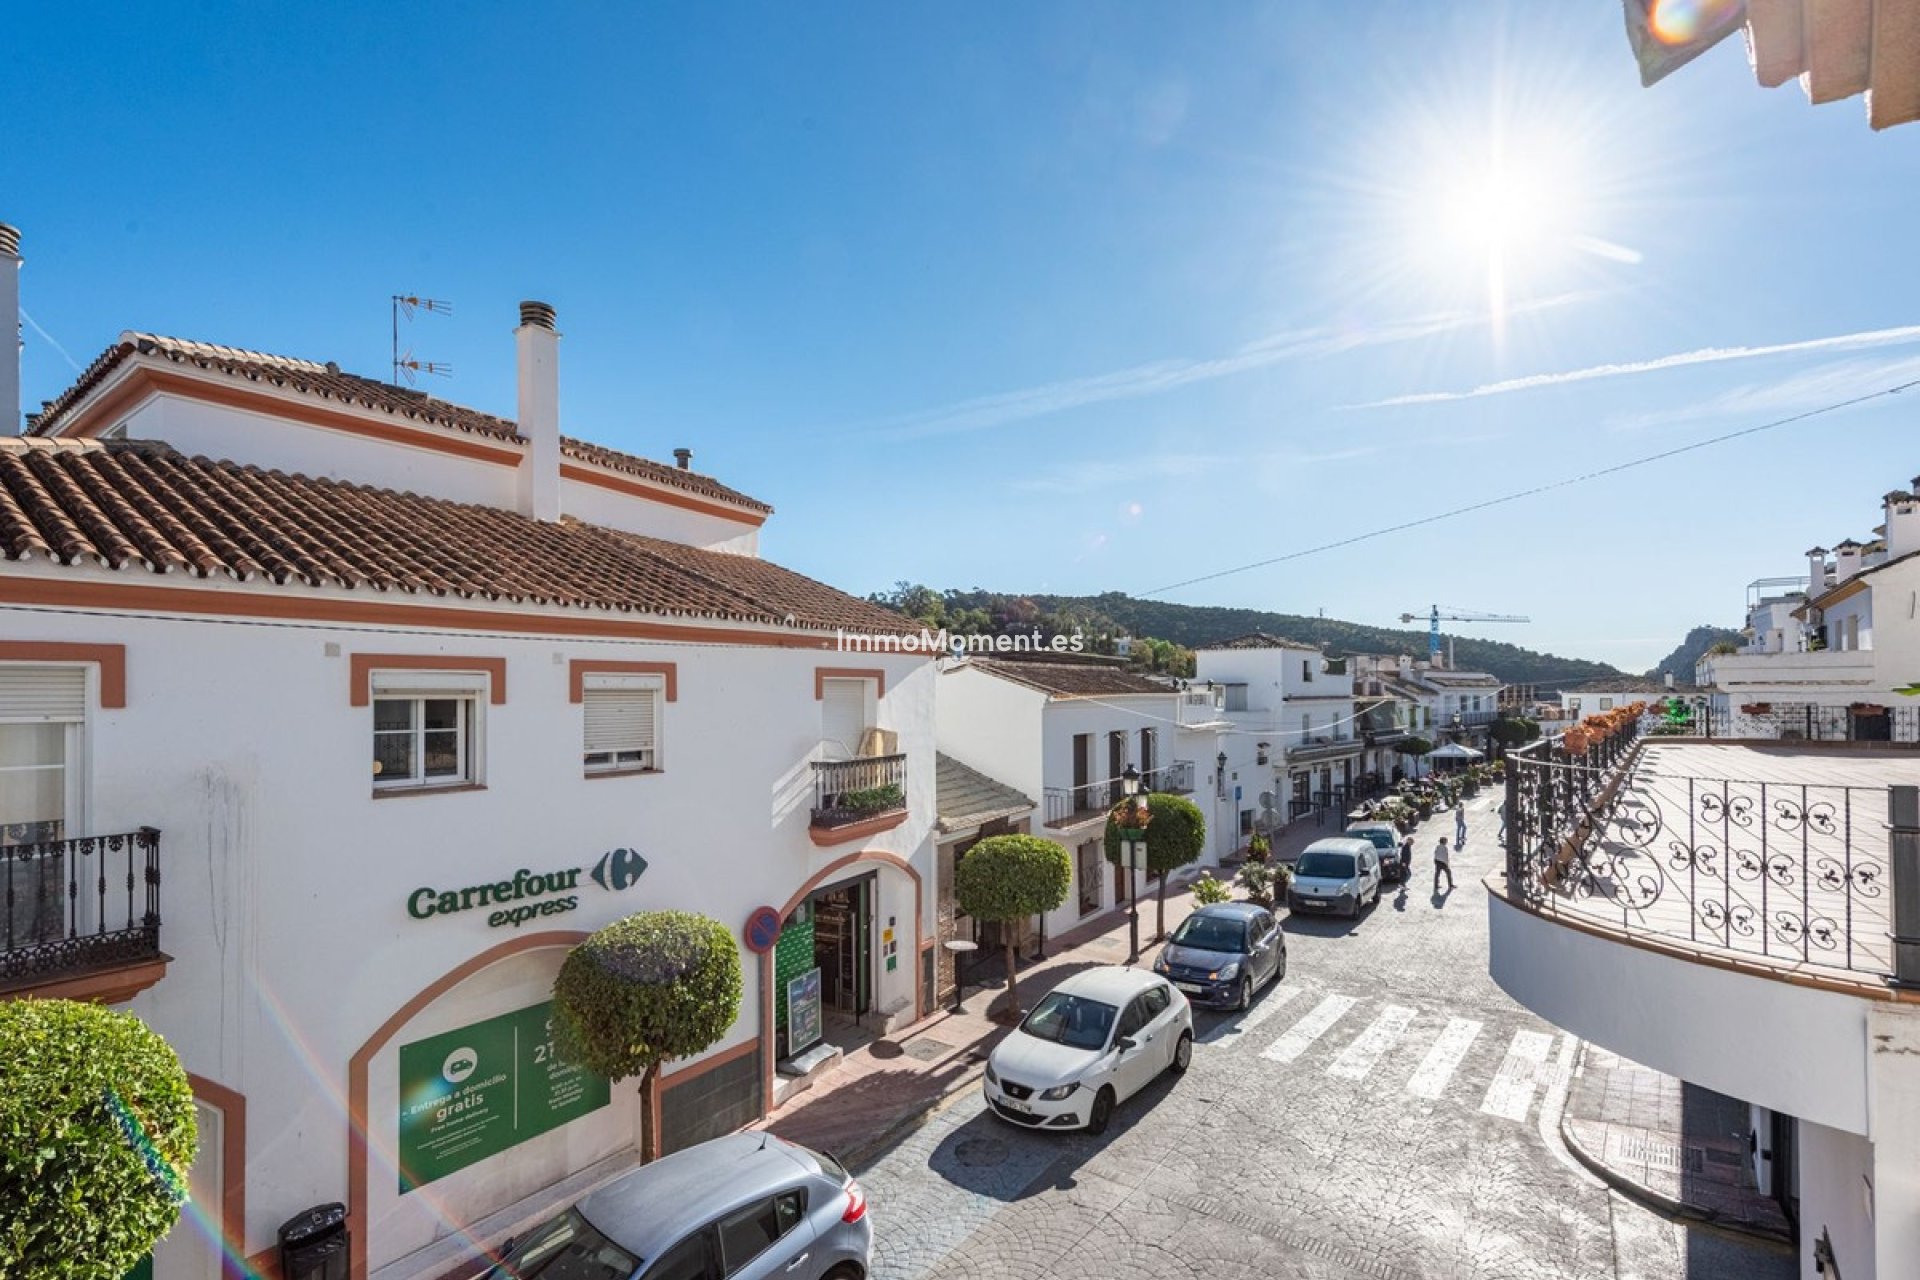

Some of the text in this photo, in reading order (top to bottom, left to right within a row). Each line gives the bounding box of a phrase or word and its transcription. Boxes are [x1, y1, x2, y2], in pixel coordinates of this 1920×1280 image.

[407, 867, 582, 919] Carrefour
[488, 895, 579, 928] express
[410, 1073, 507, 1115] Entrega a domicilio
[436, 1093, 484, 1123] gratis
